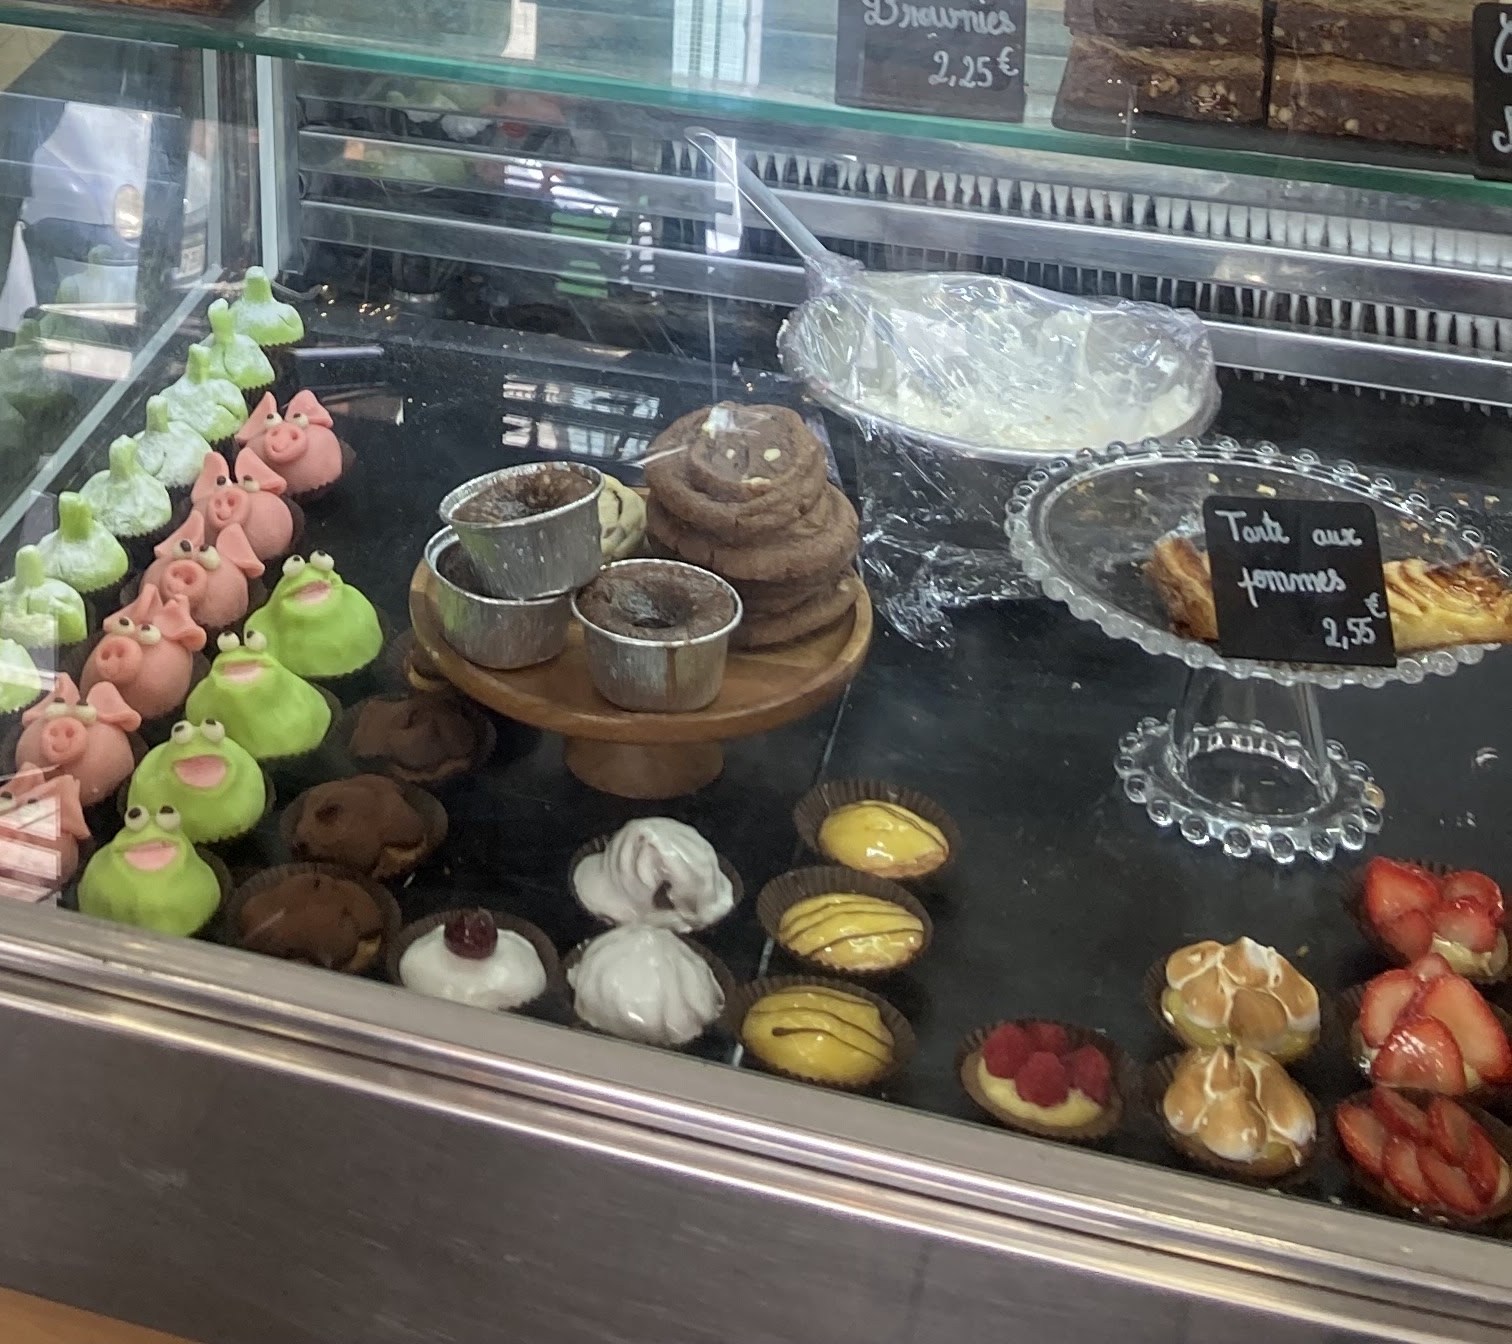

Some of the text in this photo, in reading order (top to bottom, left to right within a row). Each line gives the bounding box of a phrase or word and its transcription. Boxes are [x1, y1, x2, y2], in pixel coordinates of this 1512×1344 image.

[928, 46, 1019, 89] 2,25€
[1215, 510, 1363, 546] Tarte aux
[1238, 567, 1346, 608] pommes
[1322, 592, 1387, 650] 2,55€
